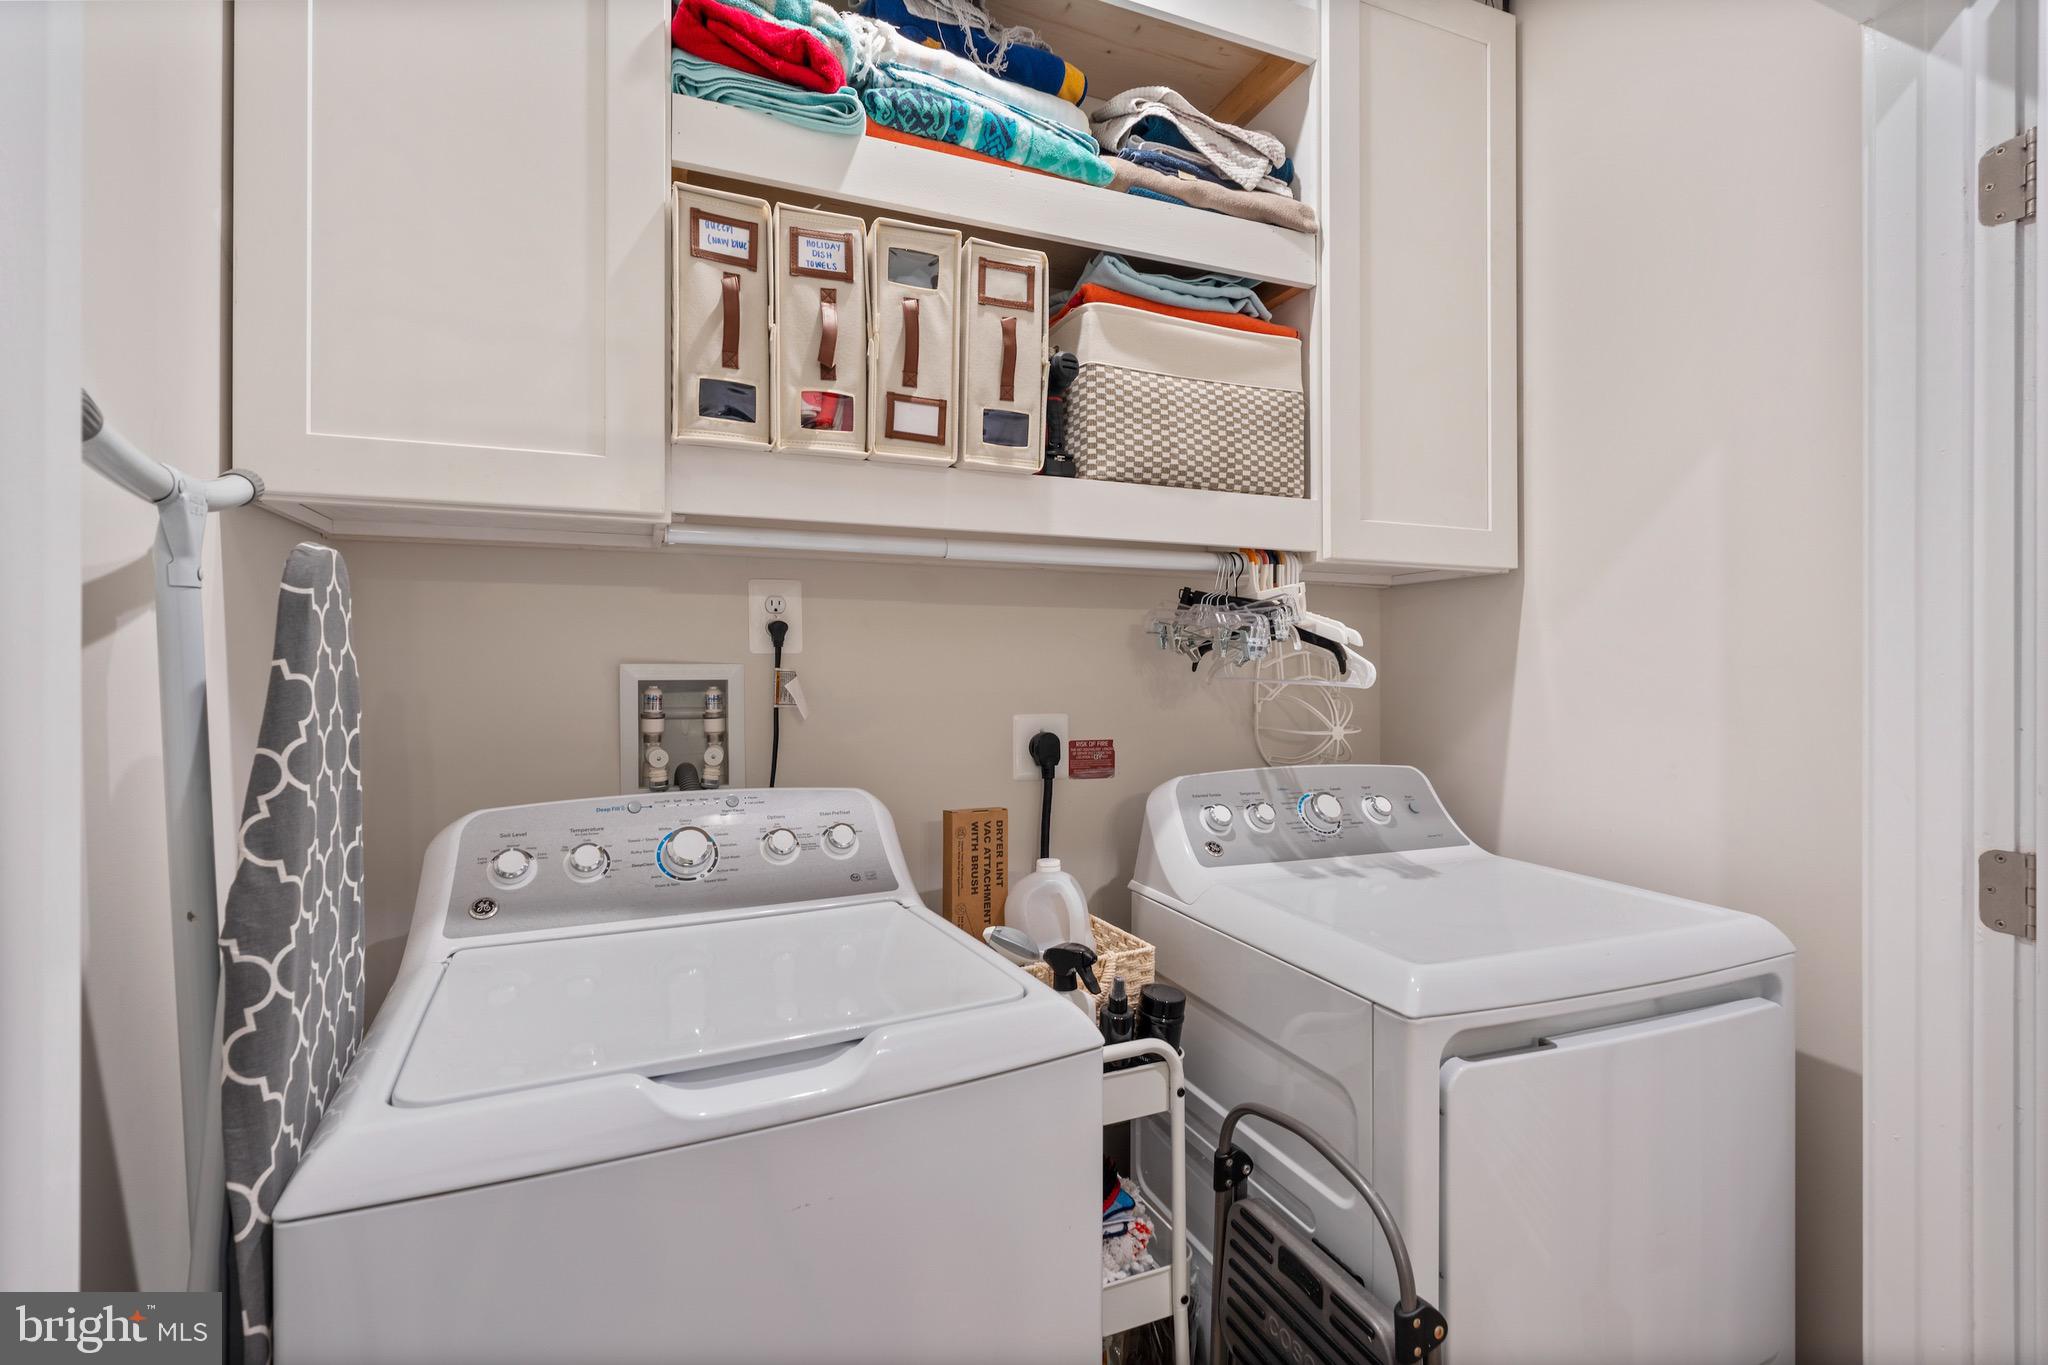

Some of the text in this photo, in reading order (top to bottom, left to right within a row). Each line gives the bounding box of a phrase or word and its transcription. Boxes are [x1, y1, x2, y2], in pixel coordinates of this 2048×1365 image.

[806, 239, 841, 252] HOLIDAY
[806, 259, 838, 271] TOWELS
[812, 249, 832, 259] DISH
[971, 821, 979, 896] WITH BRUSH
[983, 820, 992, 926] VAC ATTACHMENT
[995, 820, 1004, 888] DRYER LINT
